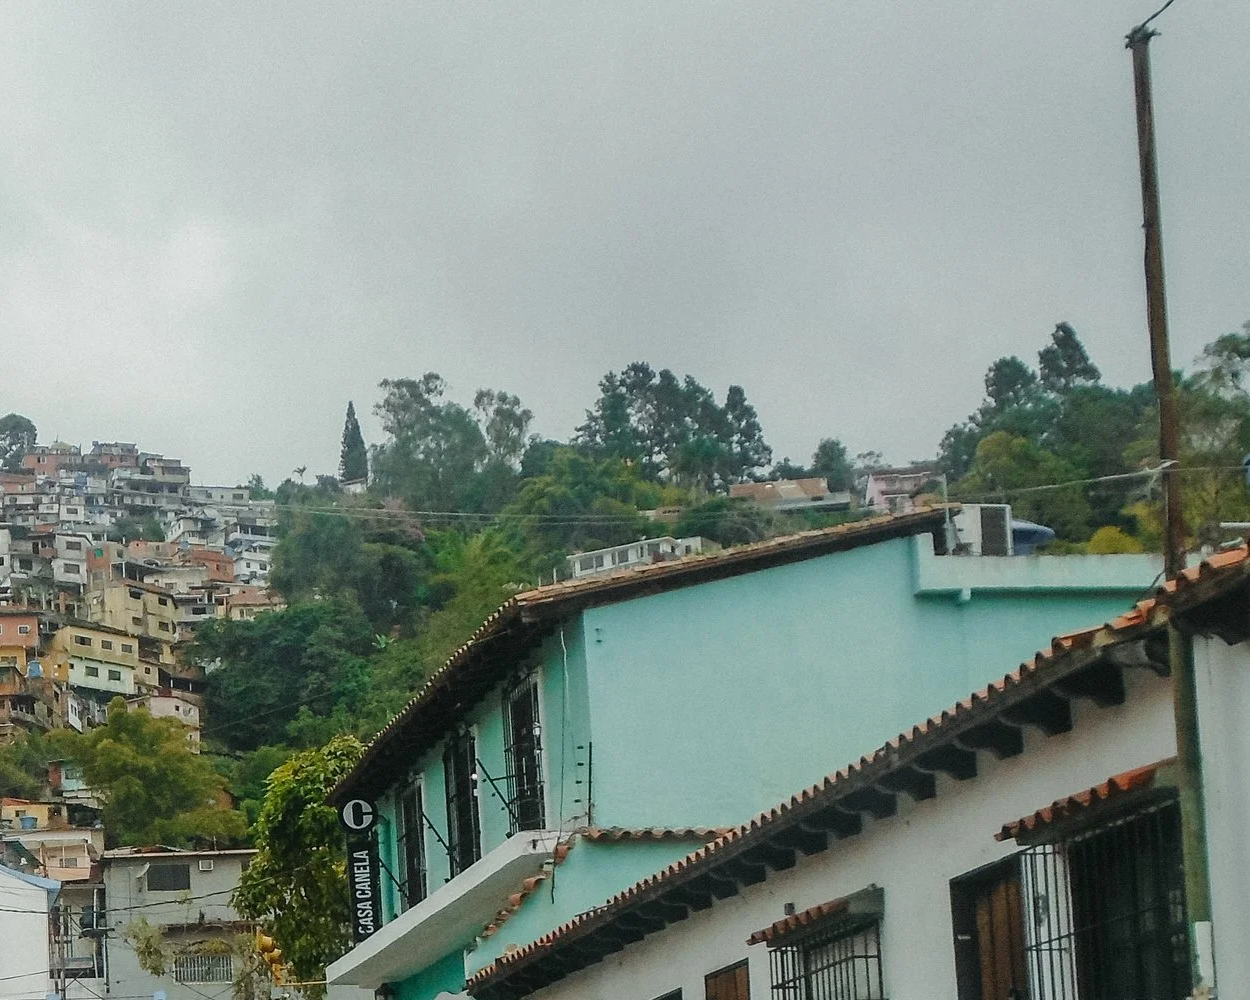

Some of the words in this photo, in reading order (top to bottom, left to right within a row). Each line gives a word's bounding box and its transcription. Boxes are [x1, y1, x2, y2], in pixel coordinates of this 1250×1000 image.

[342, 799, 374, 830] C
[353, 850, 372, 899] CANELA
[357, 901, 375, 934] CASA
